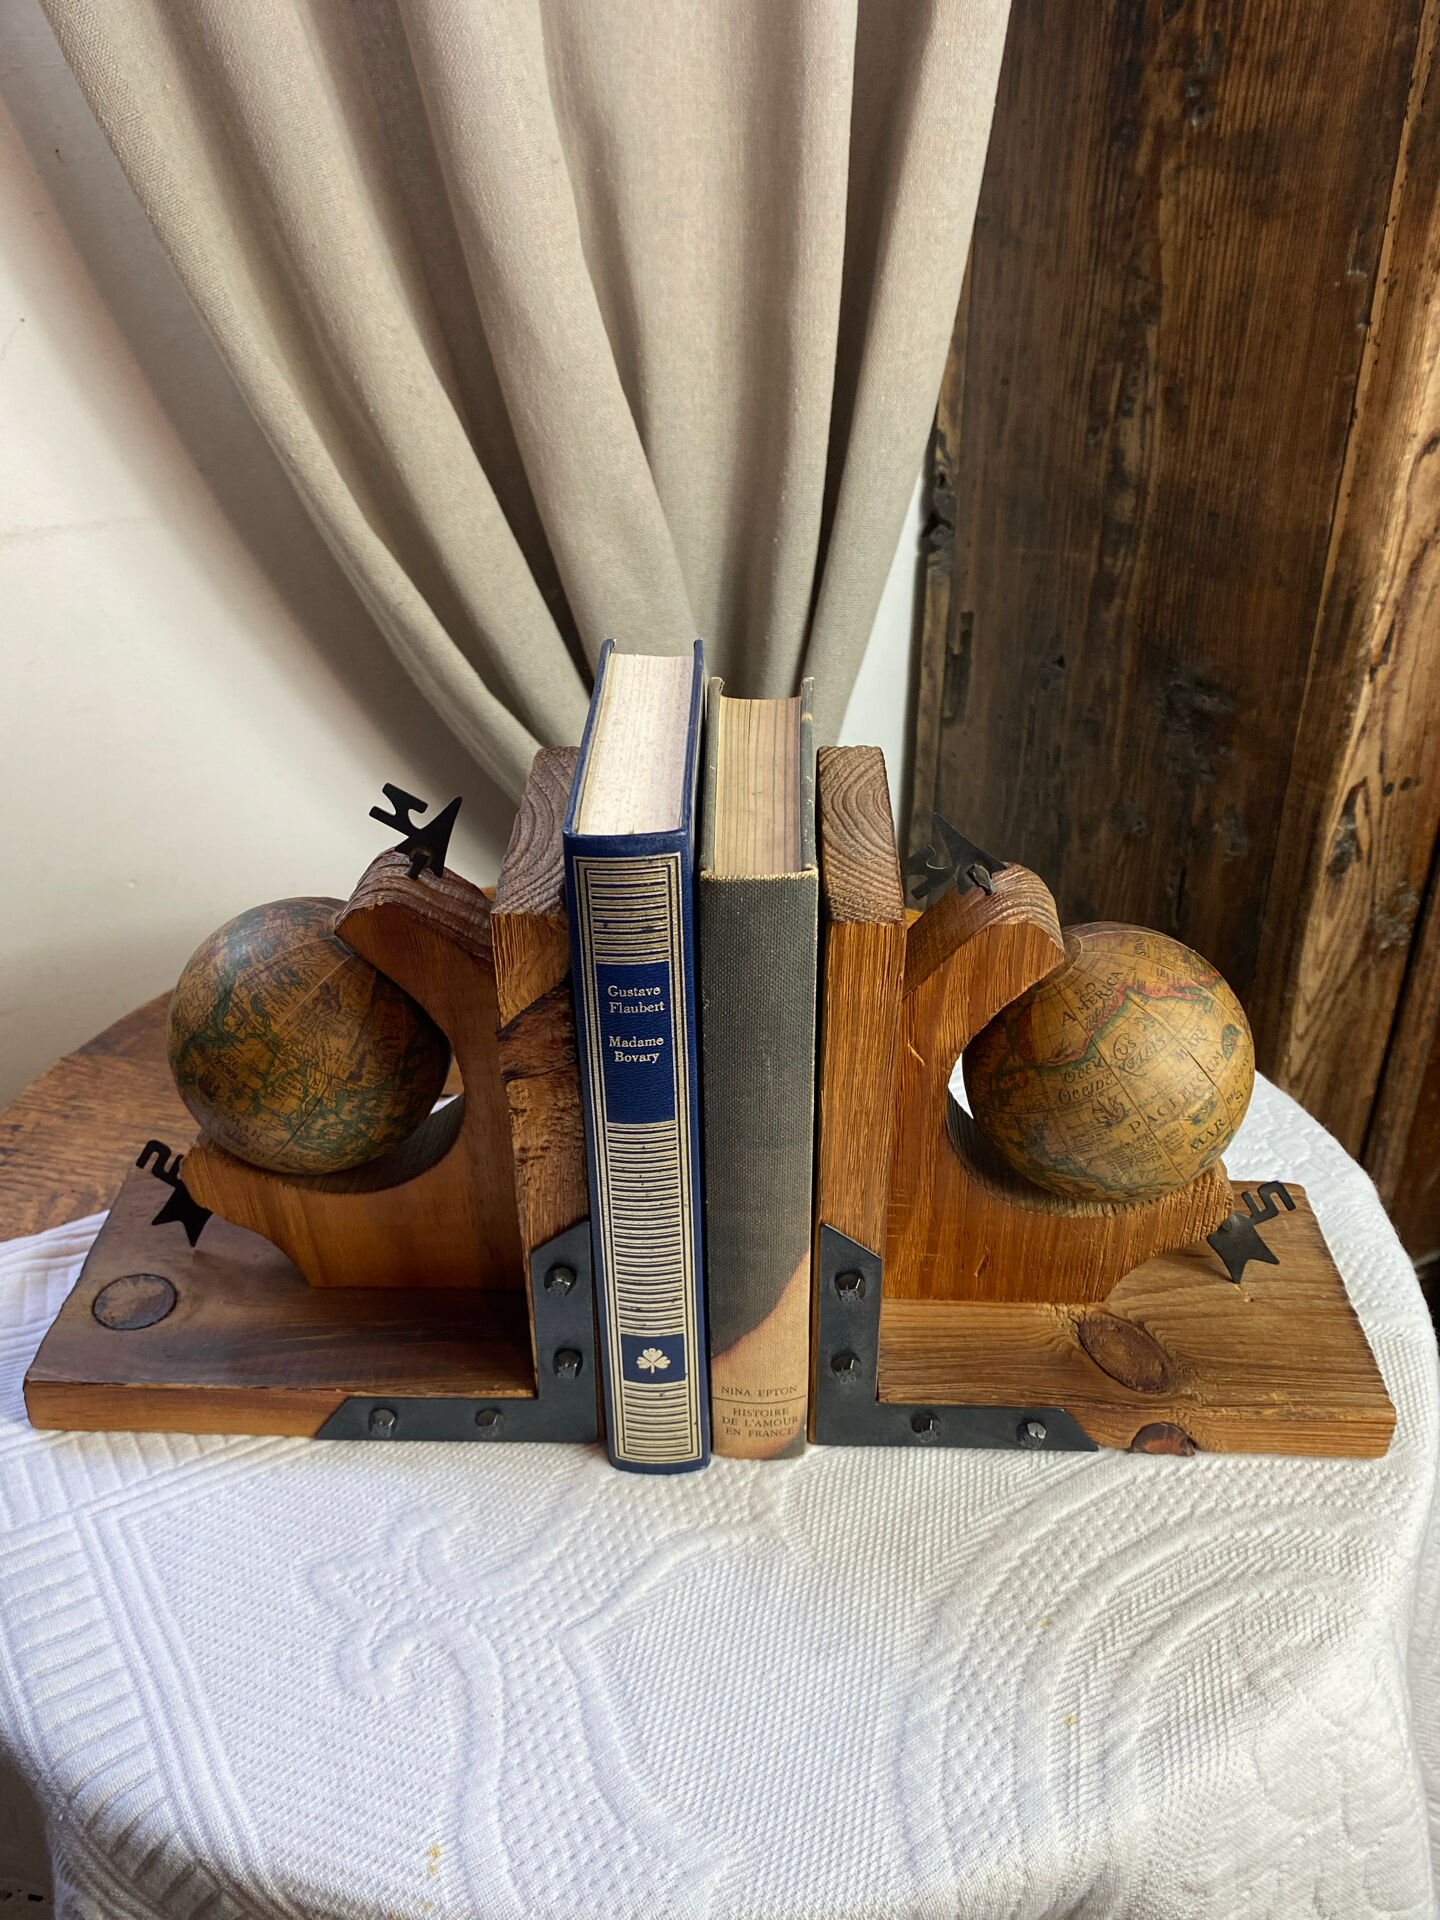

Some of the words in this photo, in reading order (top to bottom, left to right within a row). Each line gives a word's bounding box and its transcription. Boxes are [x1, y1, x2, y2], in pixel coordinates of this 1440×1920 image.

[607, 985, 661, 997] Gustave
[609, 1001, 665, 1014] Flaubert
[609, 1035, 665, 1048] Madame
[614, 1051, 660, 1064] Bovary
[721, 1386, 751, 1397] NINA
[758, 1385, 798, 1397] EPTON
[733, 1408, 789, 1417] HISTOIRE
[722, 1416, 738, 1425] DE
[744, 1416, 799, 1427] L'AMOUR
[726, 1427, 741, 1436] EN
[748, 1427, 794, 1437] FRANCE
